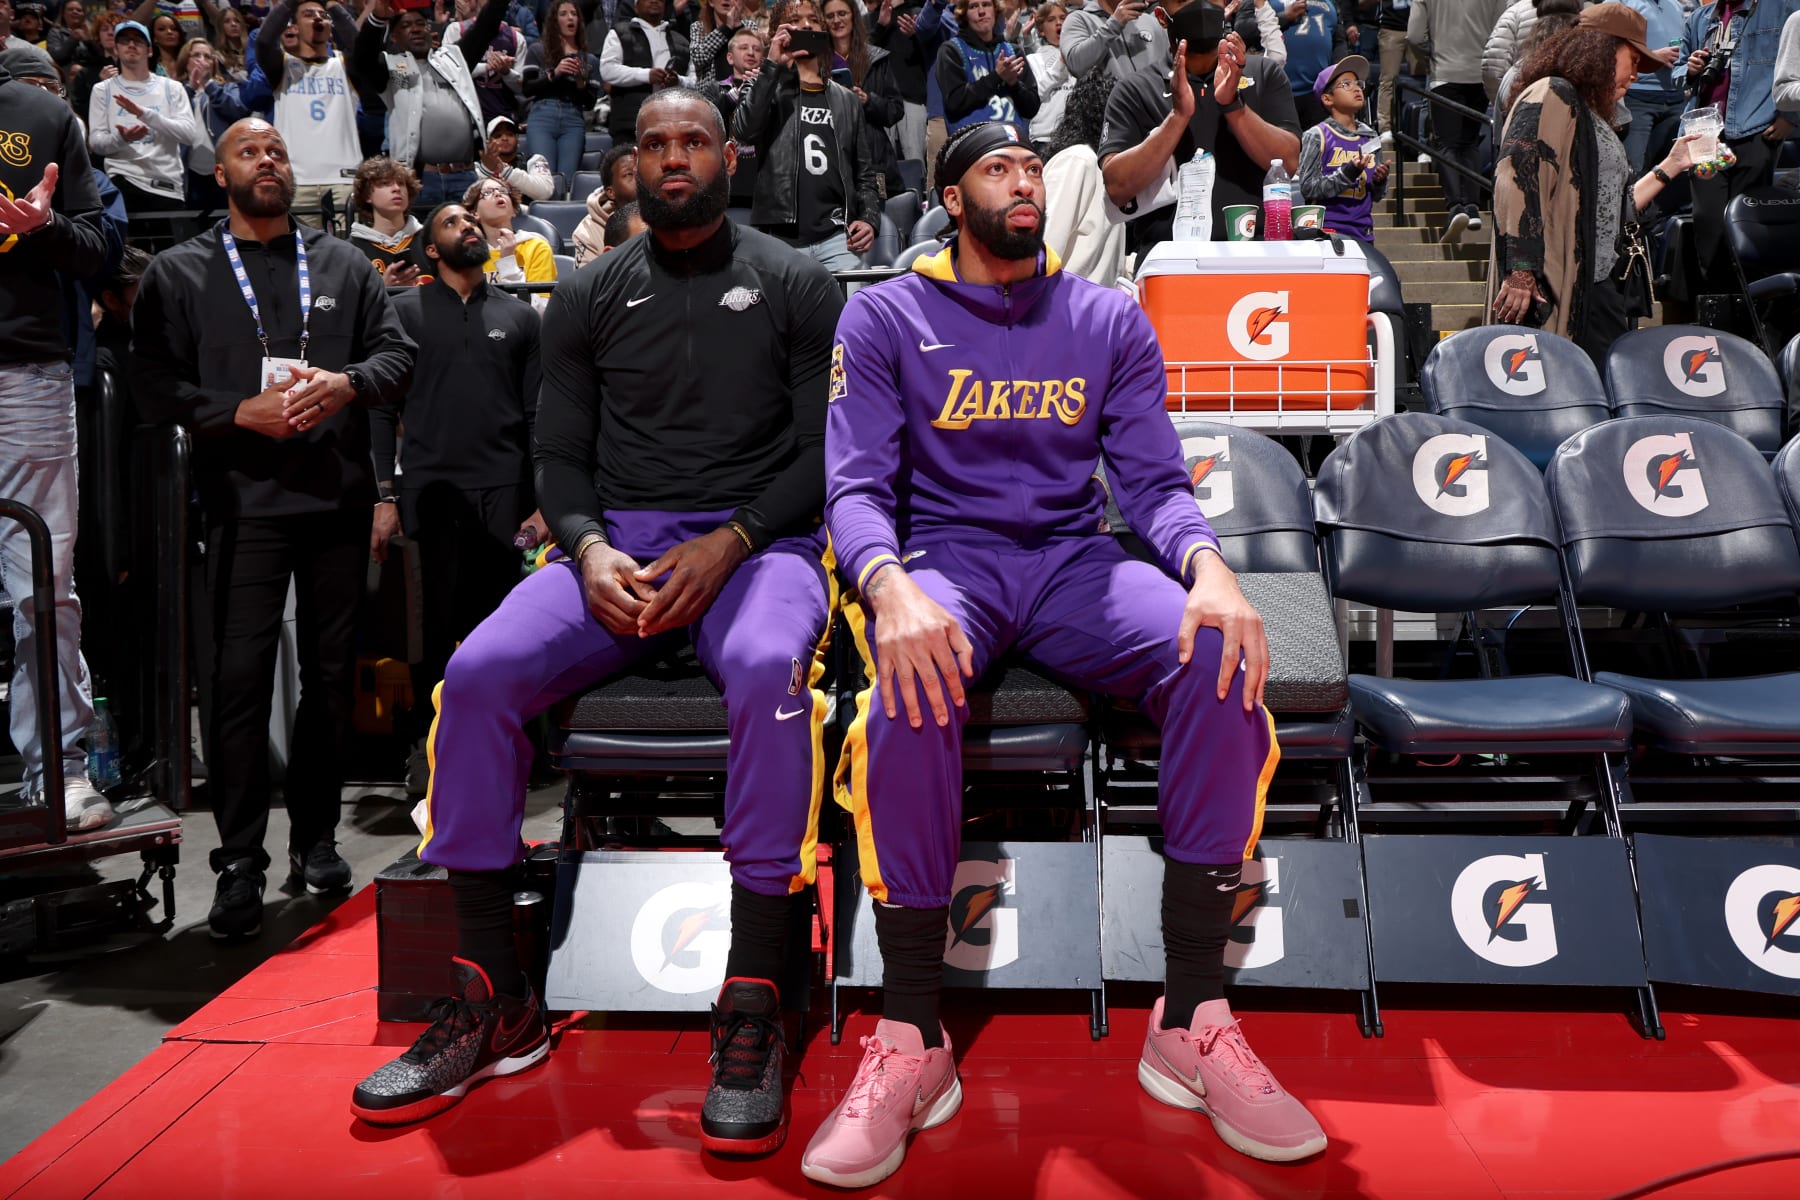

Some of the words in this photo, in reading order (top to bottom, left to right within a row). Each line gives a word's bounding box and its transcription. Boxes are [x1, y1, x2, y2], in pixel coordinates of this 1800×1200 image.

[287, 76, 345, 95] LAKERS
[310, 99, 326, 122] 6
[988, 94, 1015, 122] 32
[803, 133, 829, 176] 6
[1326, 146, 1376, 169] LAKS
[717, 291, 761, 306] LAKERS
[1226, 289, 1291, 362] G
[1484, 333, 1547, 397] G
[1663, 335, 1728, 398] G
[930, 368, 1087, 430] LAKERS
[1412, 433, 1490, 517] G
[1623, 432, 1710, 517] G
[630, 880, 733, 995] G
[1450, 853, 1559, 968] G
